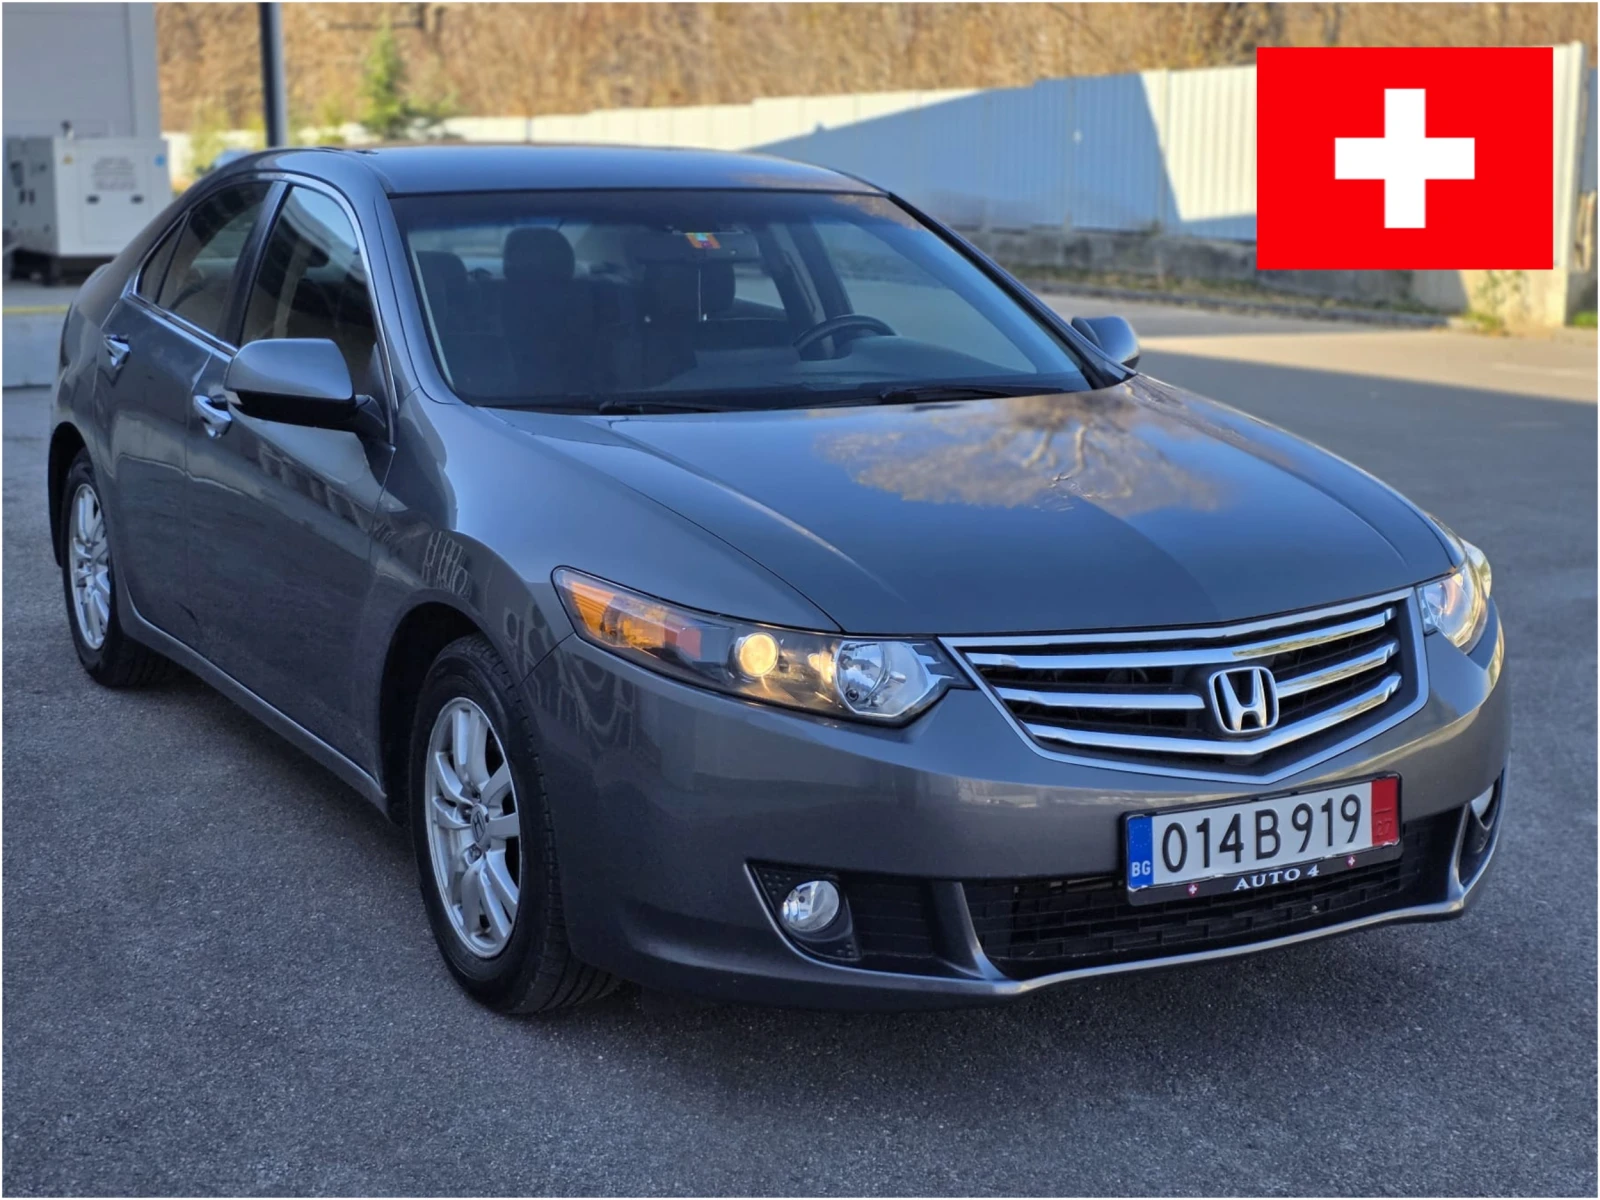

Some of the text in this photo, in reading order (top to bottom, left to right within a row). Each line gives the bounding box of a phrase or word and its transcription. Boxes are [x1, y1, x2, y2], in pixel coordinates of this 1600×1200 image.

[1162, 793, 1361, 873] 014B919
[1131, 860, 1151, 877] BG
[1233, 864, 1319, 891] AUTO 4
